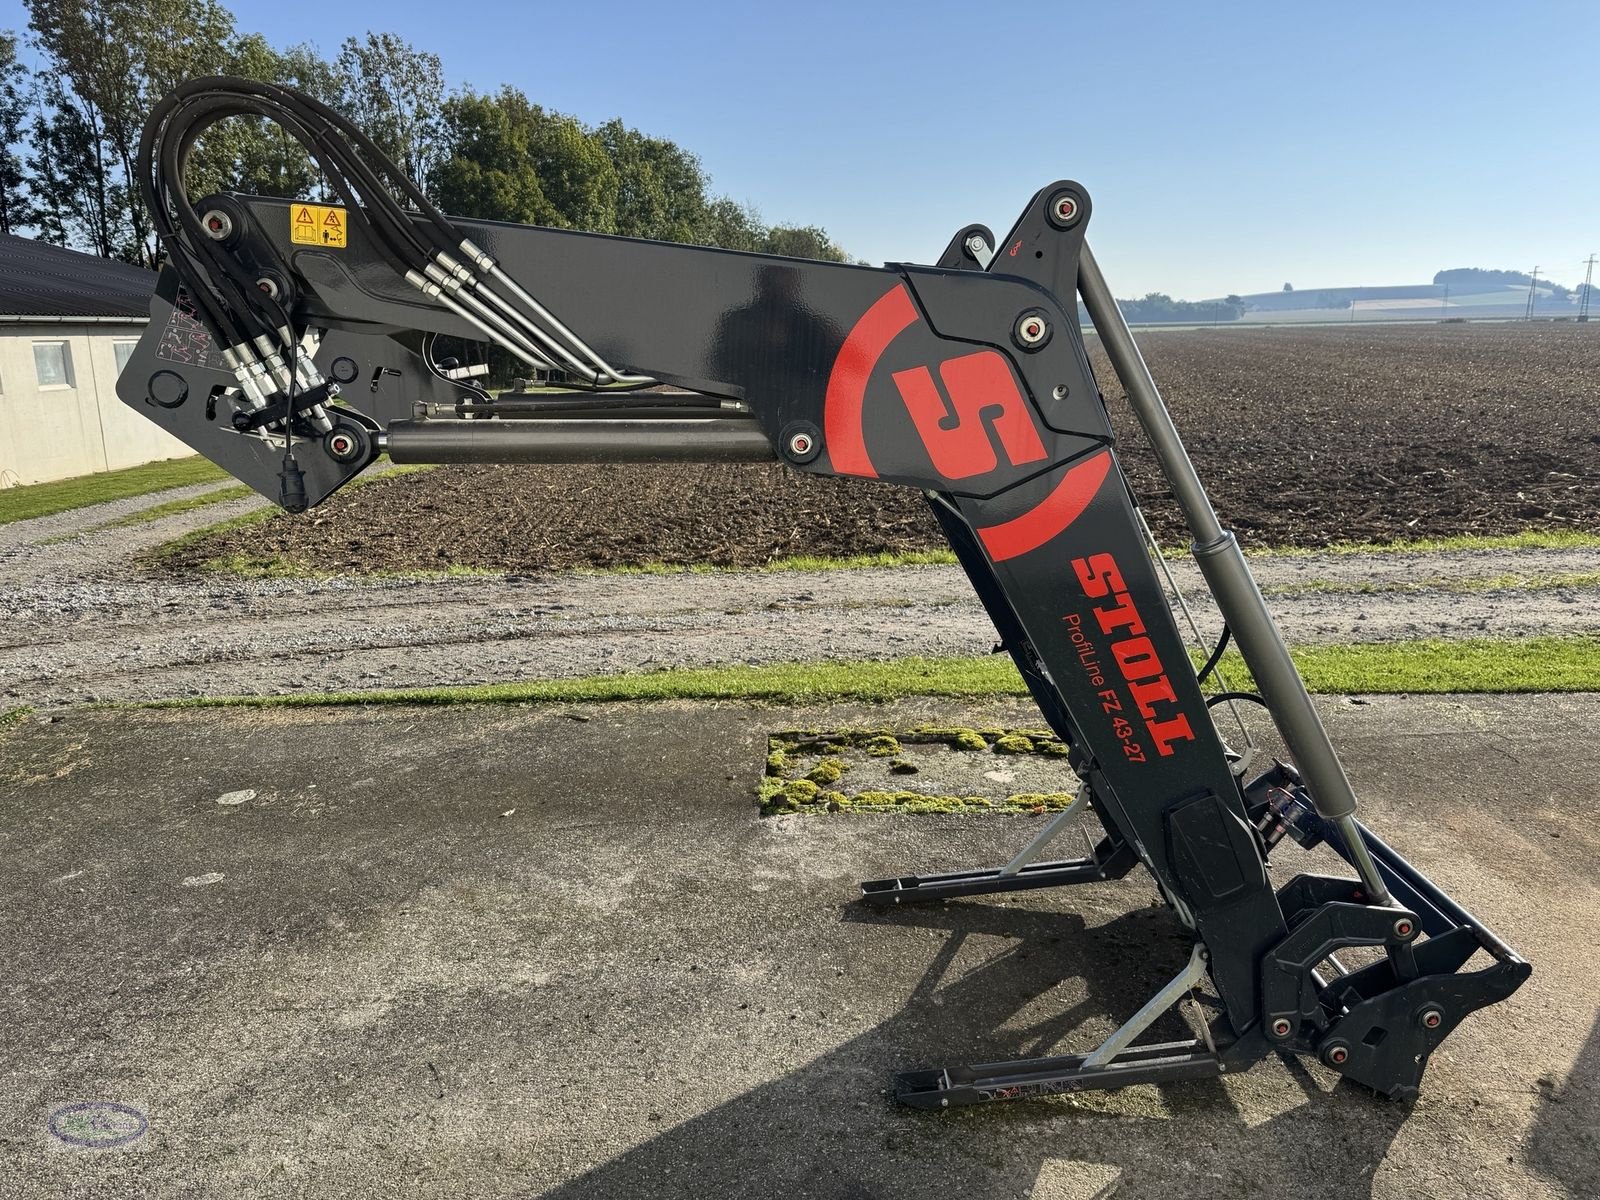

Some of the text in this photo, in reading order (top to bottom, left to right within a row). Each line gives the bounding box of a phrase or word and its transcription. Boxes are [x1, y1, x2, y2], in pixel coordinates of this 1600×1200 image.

[891, 350, 1048, 479] S
[1062, 613, 1147, 763] ProfiLine FZ 43-27
[1071, 552, 1195, 757] STOLL
